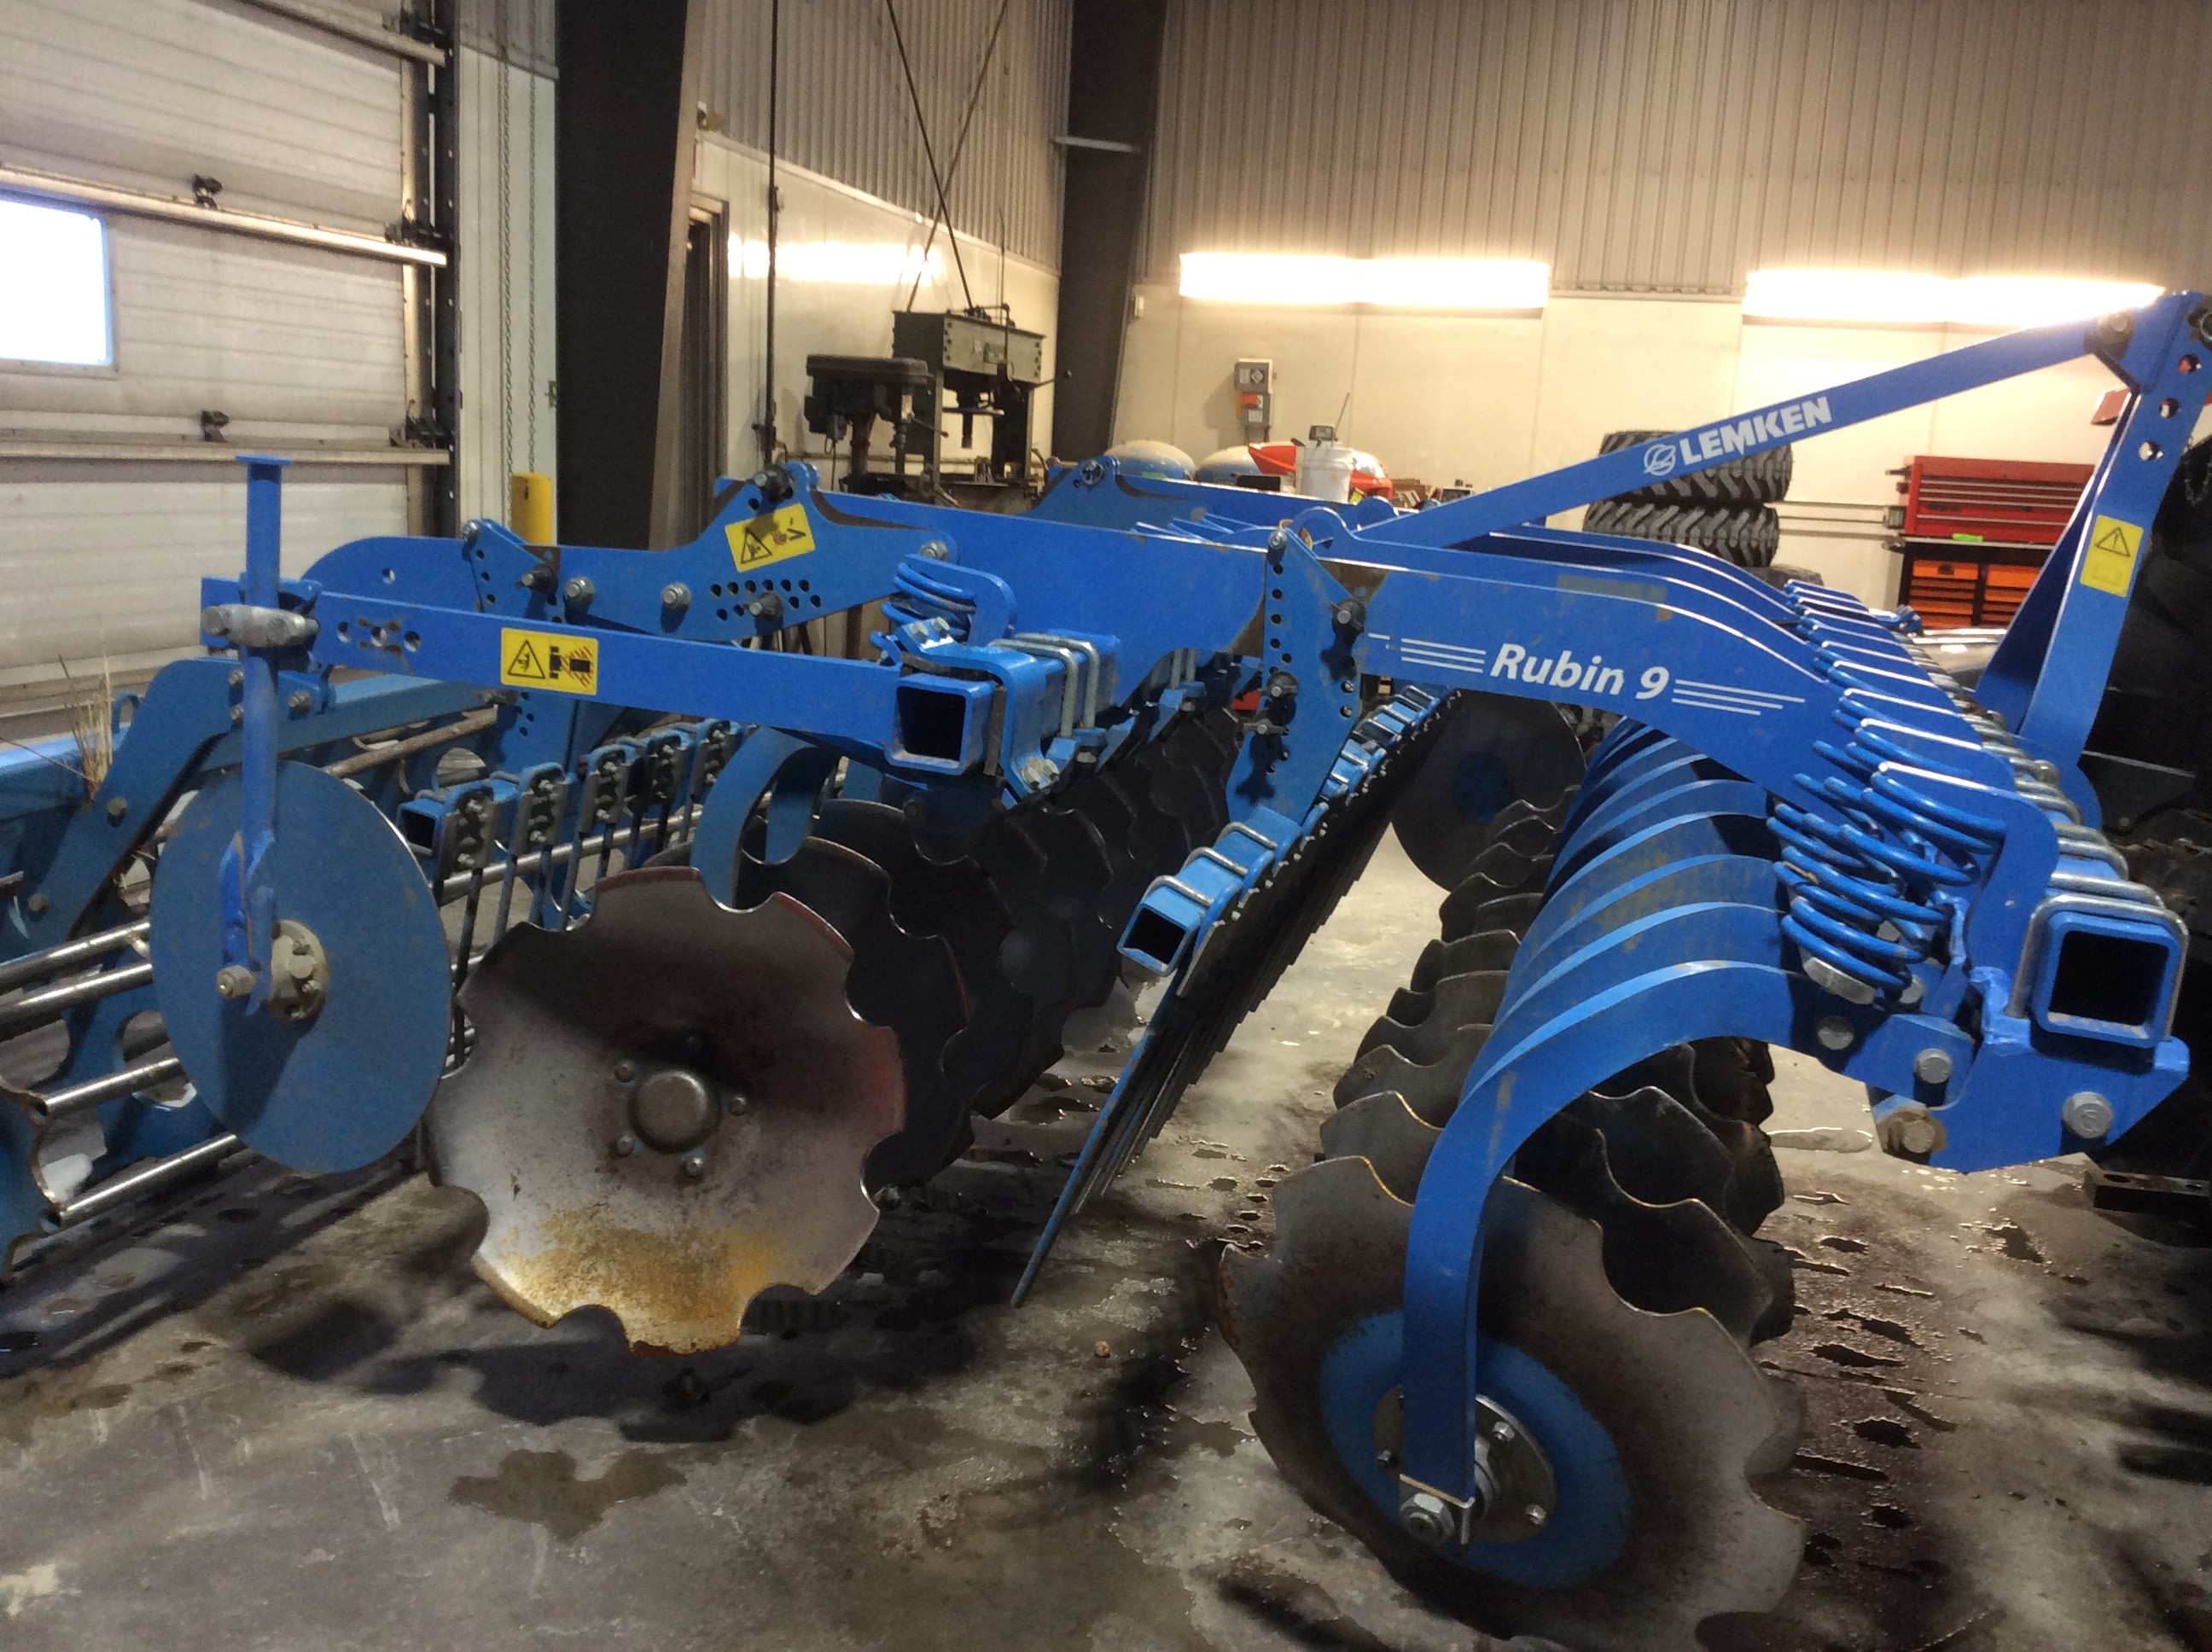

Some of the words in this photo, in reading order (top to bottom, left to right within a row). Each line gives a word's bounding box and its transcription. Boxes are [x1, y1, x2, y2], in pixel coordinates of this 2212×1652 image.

[1679, 396, 1832, 465] LEMKEN
[1490, 643, 1624, 695] Rubin
[1635, 666, 1669, 700] 9
